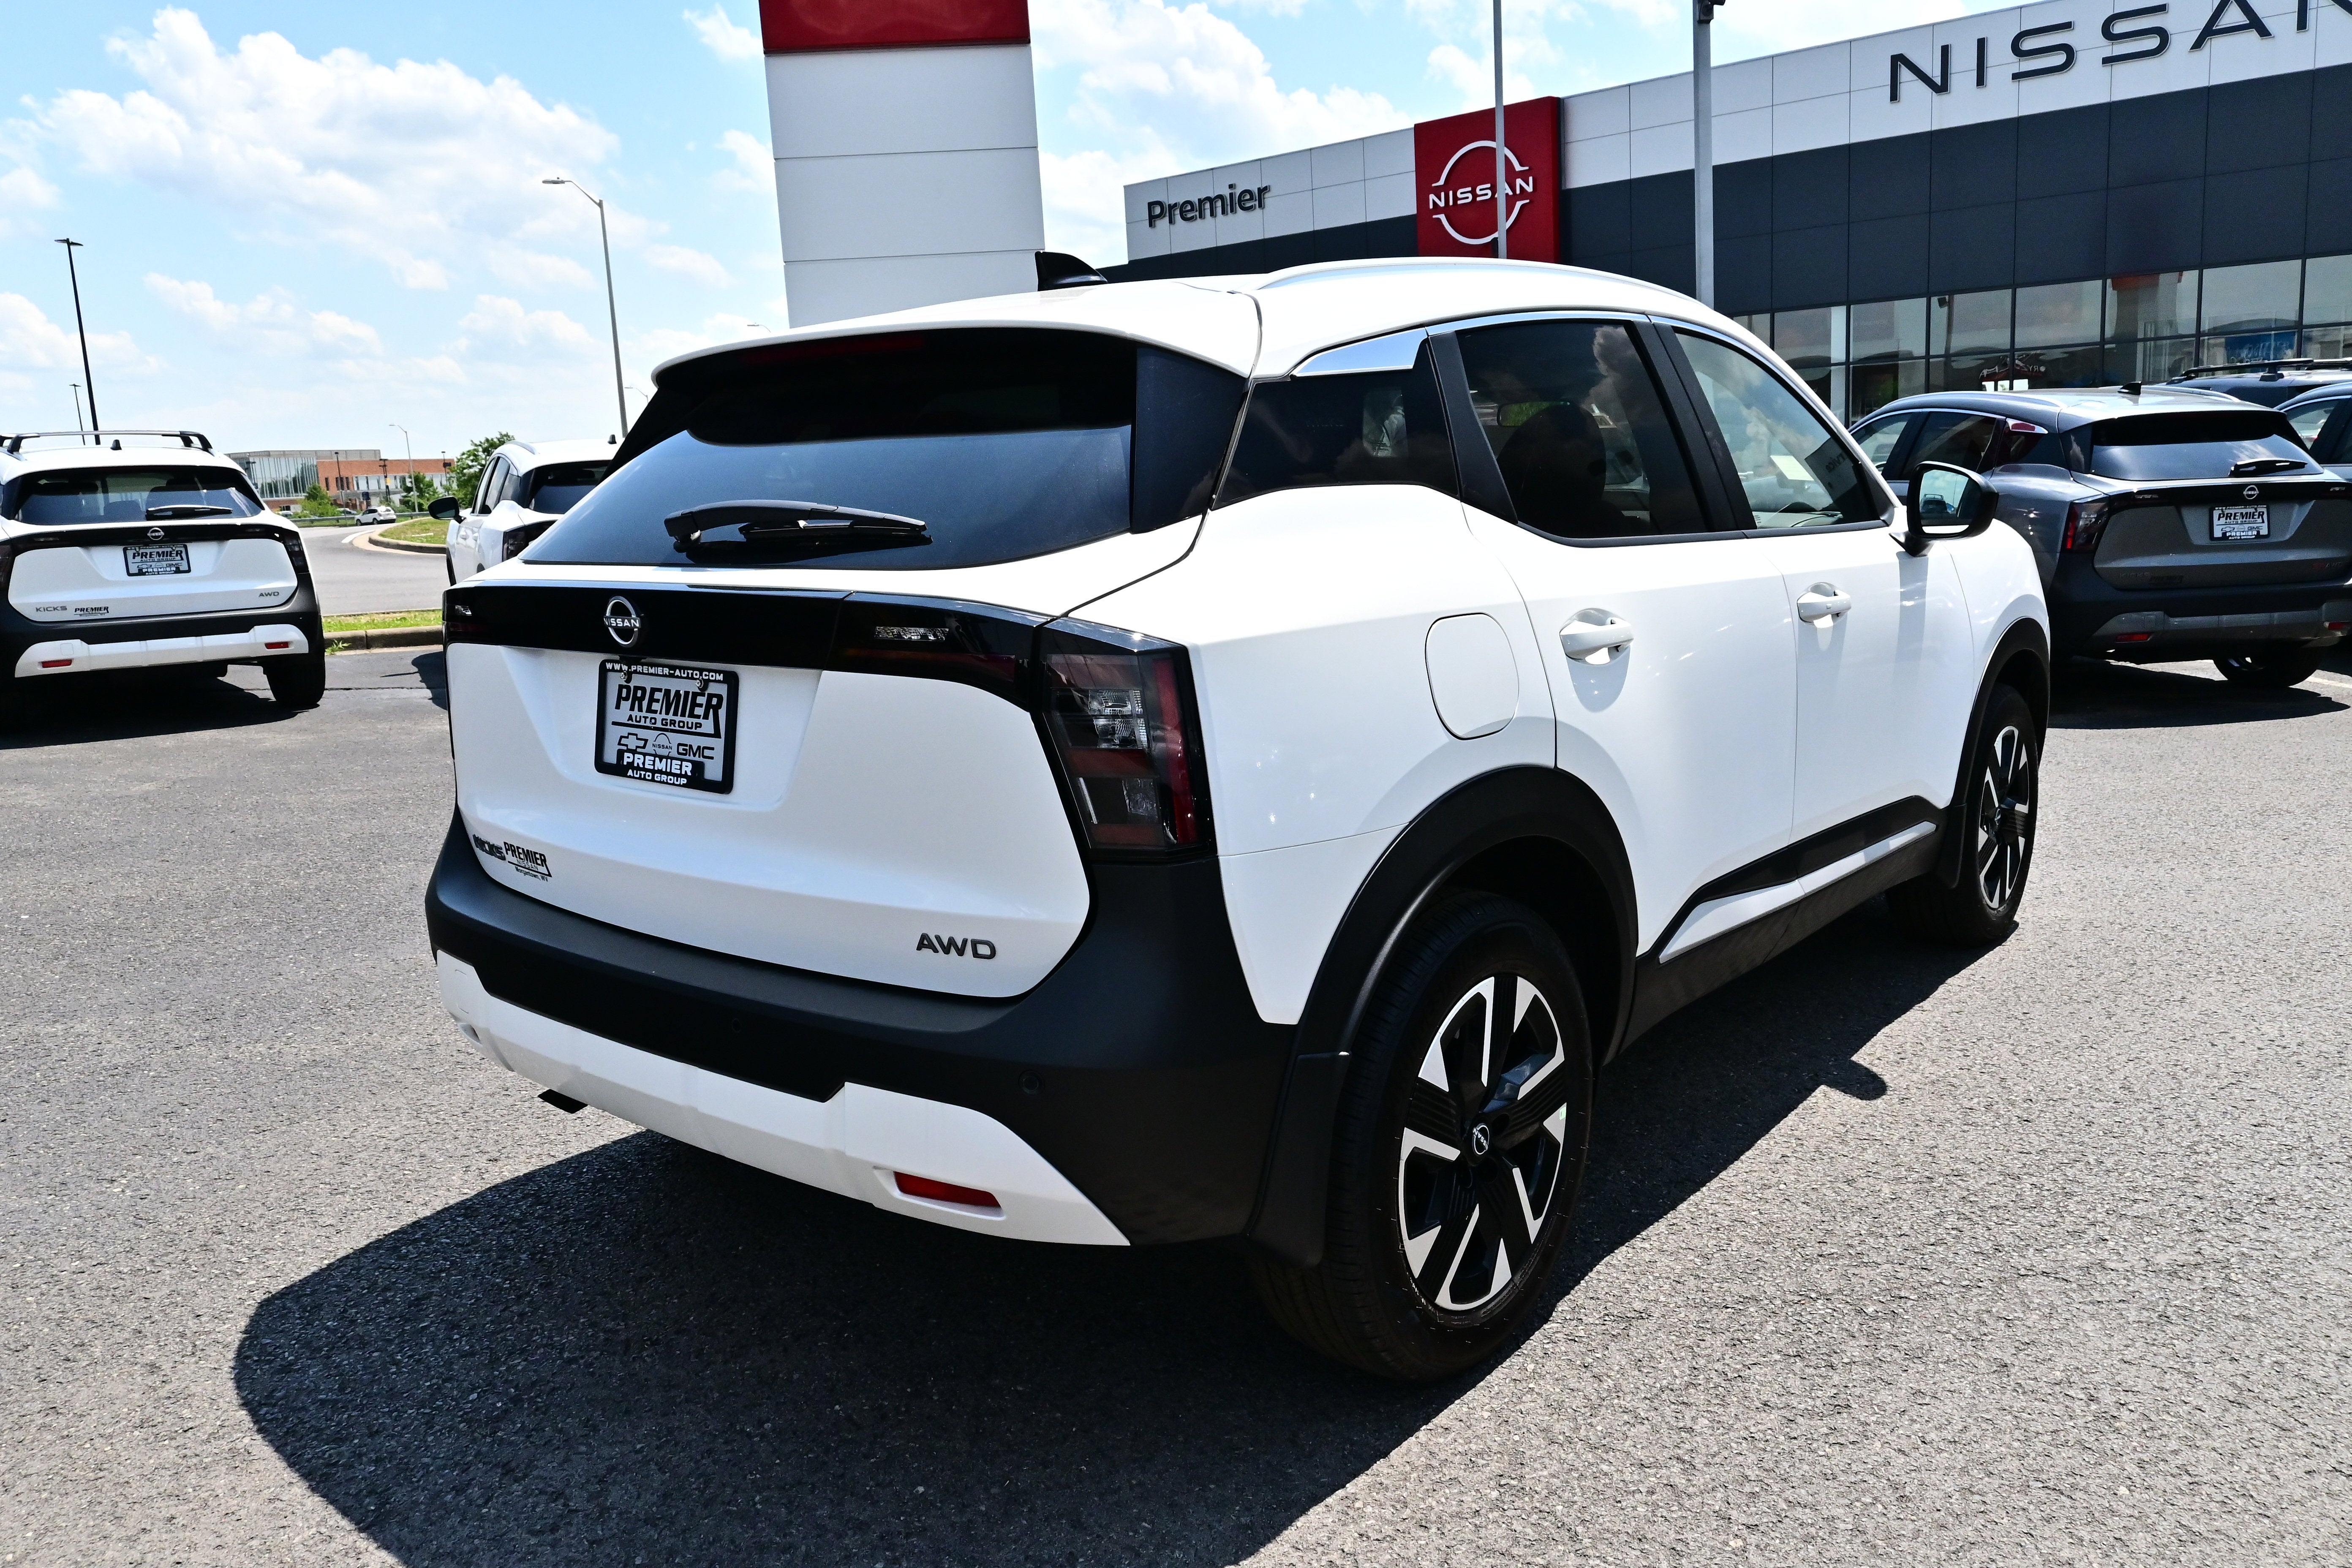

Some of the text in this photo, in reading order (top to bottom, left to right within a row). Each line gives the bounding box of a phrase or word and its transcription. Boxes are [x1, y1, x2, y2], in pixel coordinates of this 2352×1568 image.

[1147, 183, 1270, 228] Premier
[2218, 511, 2265, 521] PREMIER
[133, 550, 183, 560] PREMIER
[604, 617, 640, 628] NISSAN
[606, 662, 723, 681] WWW.PREMIER-AUTO.COM
[615, 683, 724, 722] PREMIER
[627, 714, 703, 731] AUTO GROUP
[677, 743, 715, 760] GMC
[623, 753, 692, 776] PREMIER
[627, 769, 687, 785] AUTO GROUP
[504, 841, 549, 868] PREMIER
[517, 859, 539, 871] NISSAN
[916, 933, 996, 959] AWD
